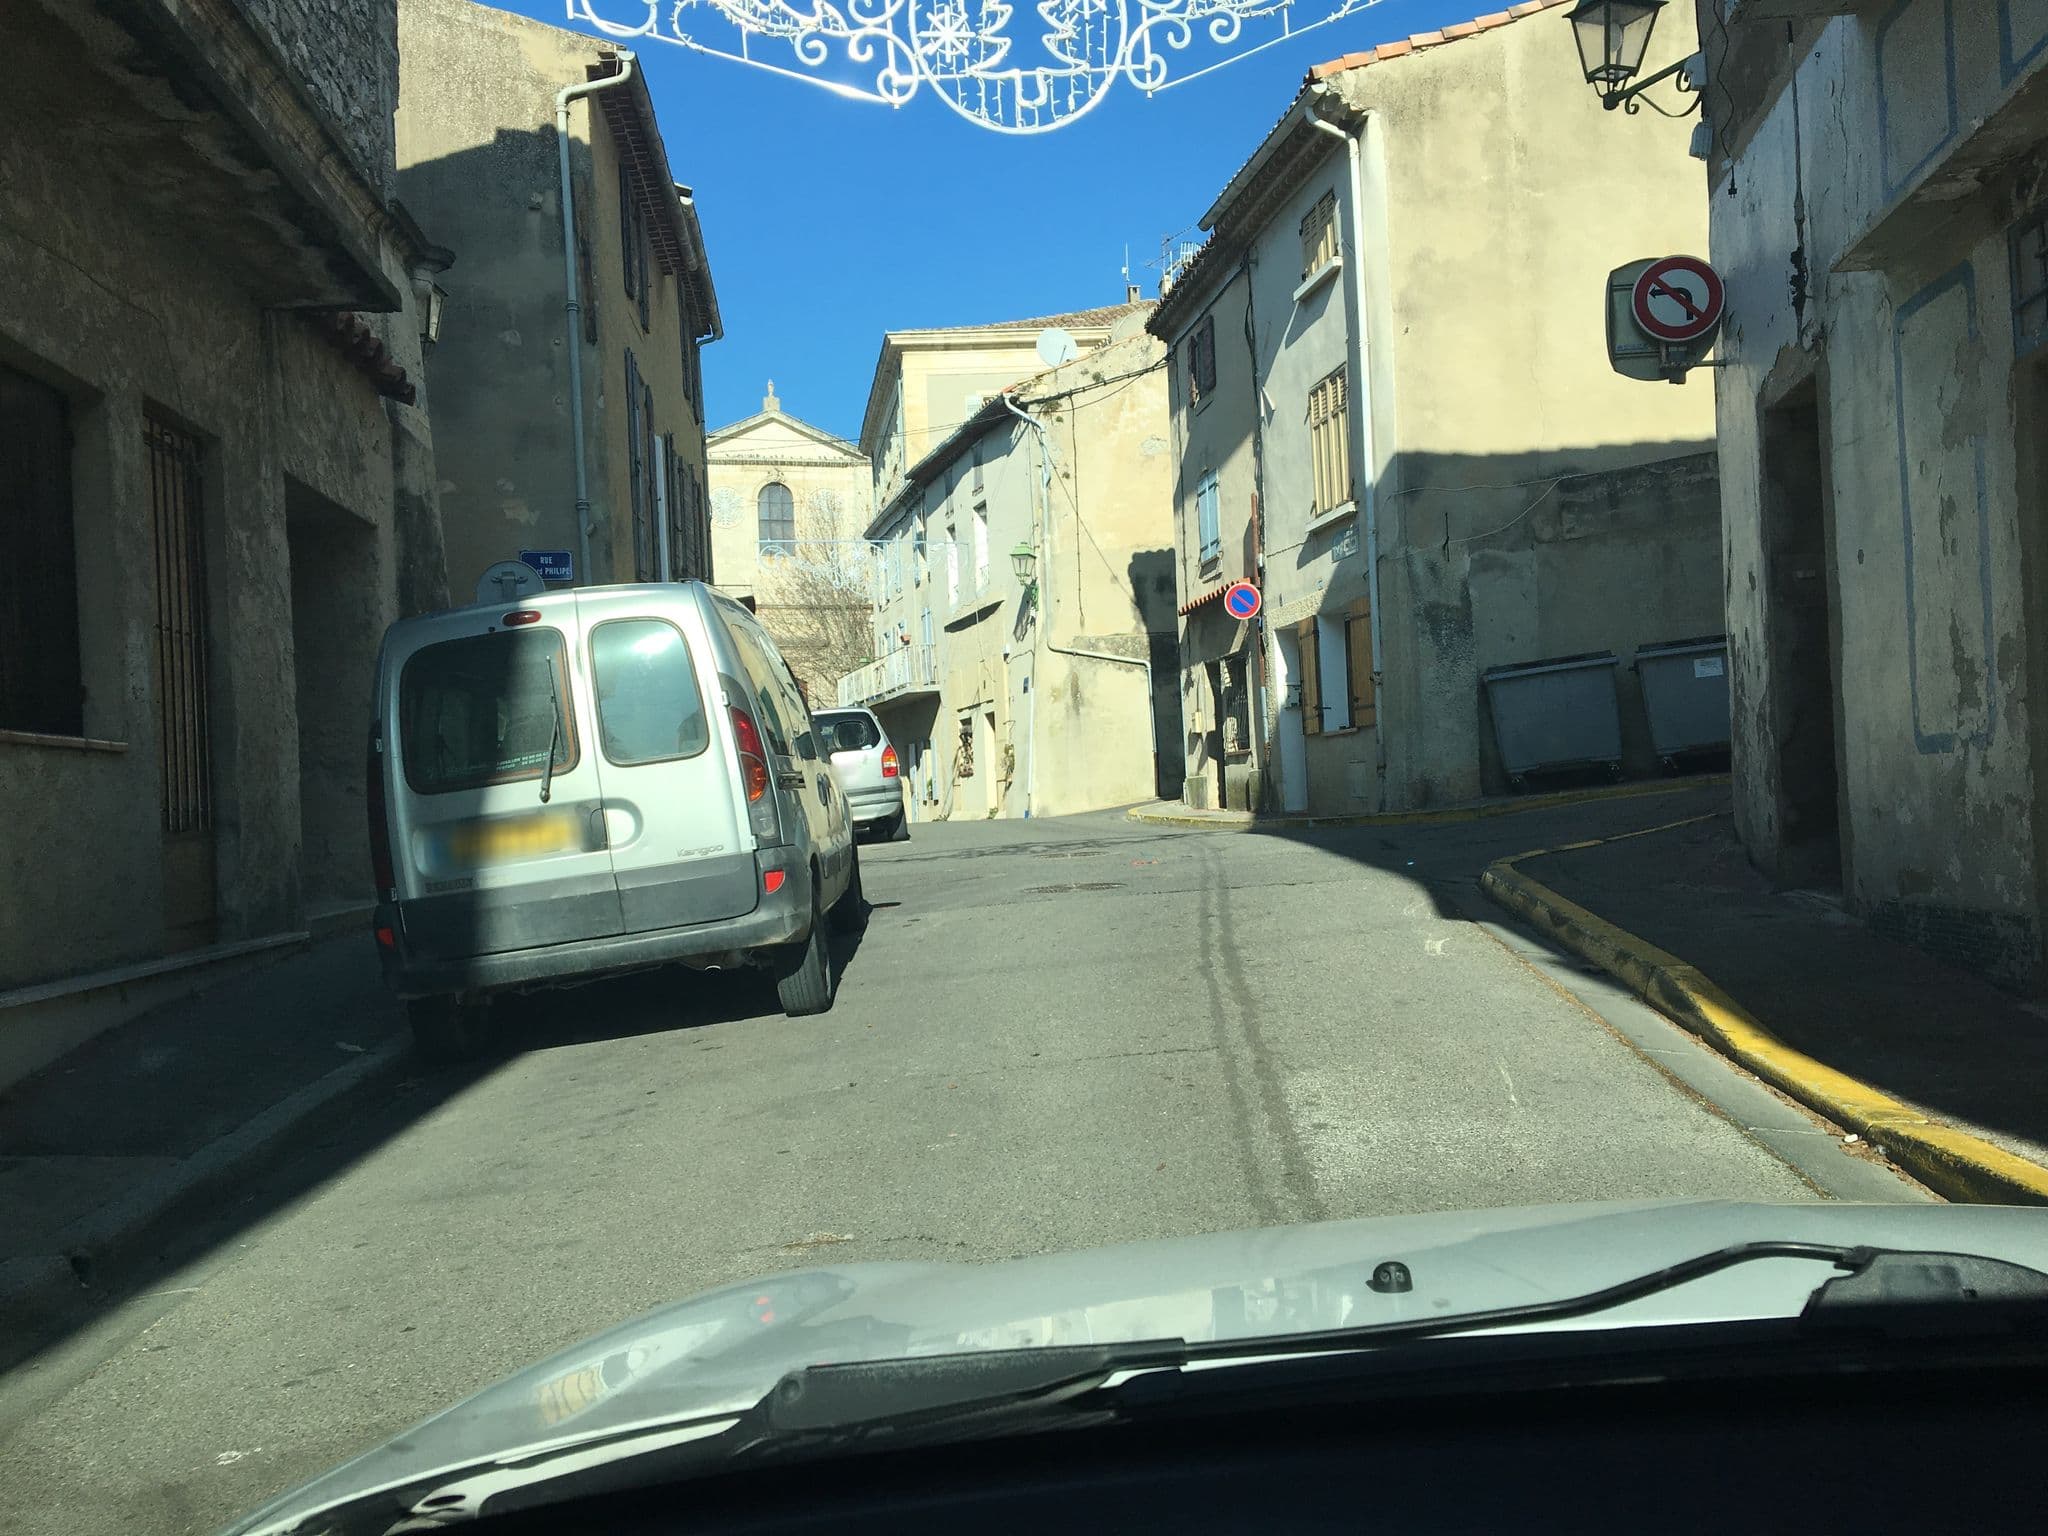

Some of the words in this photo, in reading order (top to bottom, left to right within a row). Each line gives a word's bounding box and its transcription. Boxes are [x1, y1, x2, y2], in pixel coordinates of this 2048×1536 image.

[540, 556, 552, 564] RUE
[545, 567, 570, 575] PHILIPE
[676, 844, 725, 857] Kangoo
